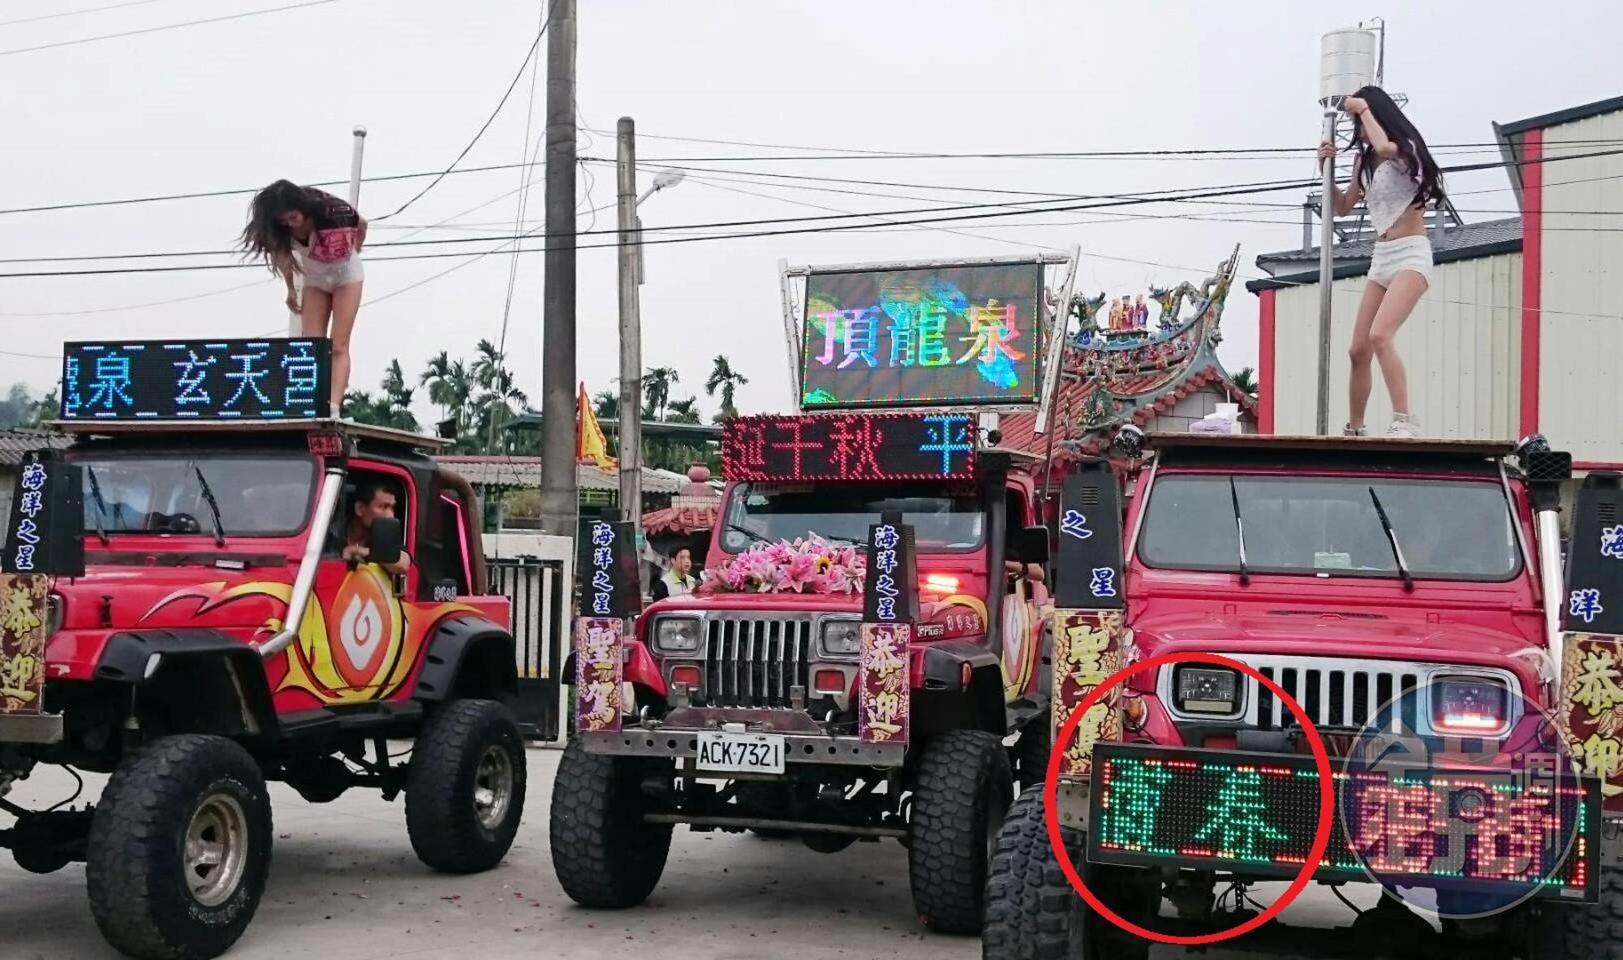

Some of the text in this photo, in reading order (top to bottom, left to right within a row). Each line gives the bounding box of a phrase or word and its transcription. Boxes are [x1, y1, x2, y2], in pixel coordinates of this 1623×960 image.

[173, 349, 317, 407] 玄天宮
[813, 299, 1026, 369] 頂龍泉
[919, 416, 973, 477] 平
[15, 463, 47, 570] 海洋之星
[1061, 509, 1116, 597] 之星
[592, 523, 615, 614] 海洋之星
[874, 524, 900, 620] 海洋之星
[866, 634, 903, 734] 恭迎
